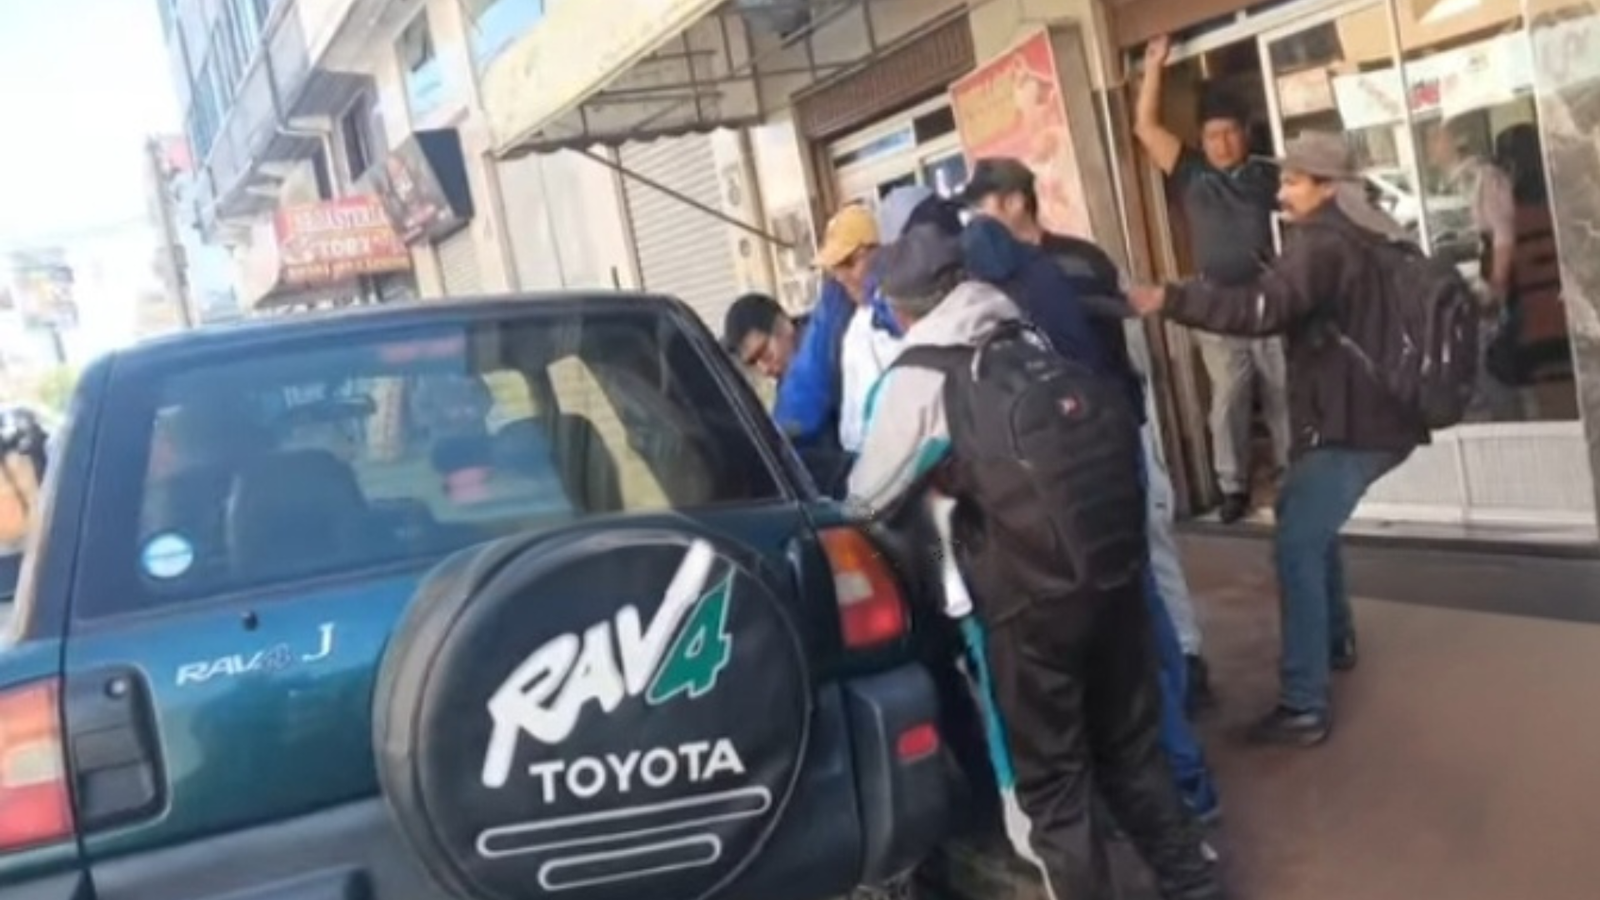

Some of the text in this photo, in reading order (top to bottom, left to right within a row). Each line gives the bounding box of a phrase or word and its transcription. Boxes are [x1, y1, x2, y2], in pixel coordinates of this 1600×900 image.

[302, 622, 335, 661] J
[482, 538, 737, 788] RAV4
[529, 738, 746, 804] TOYOTA
